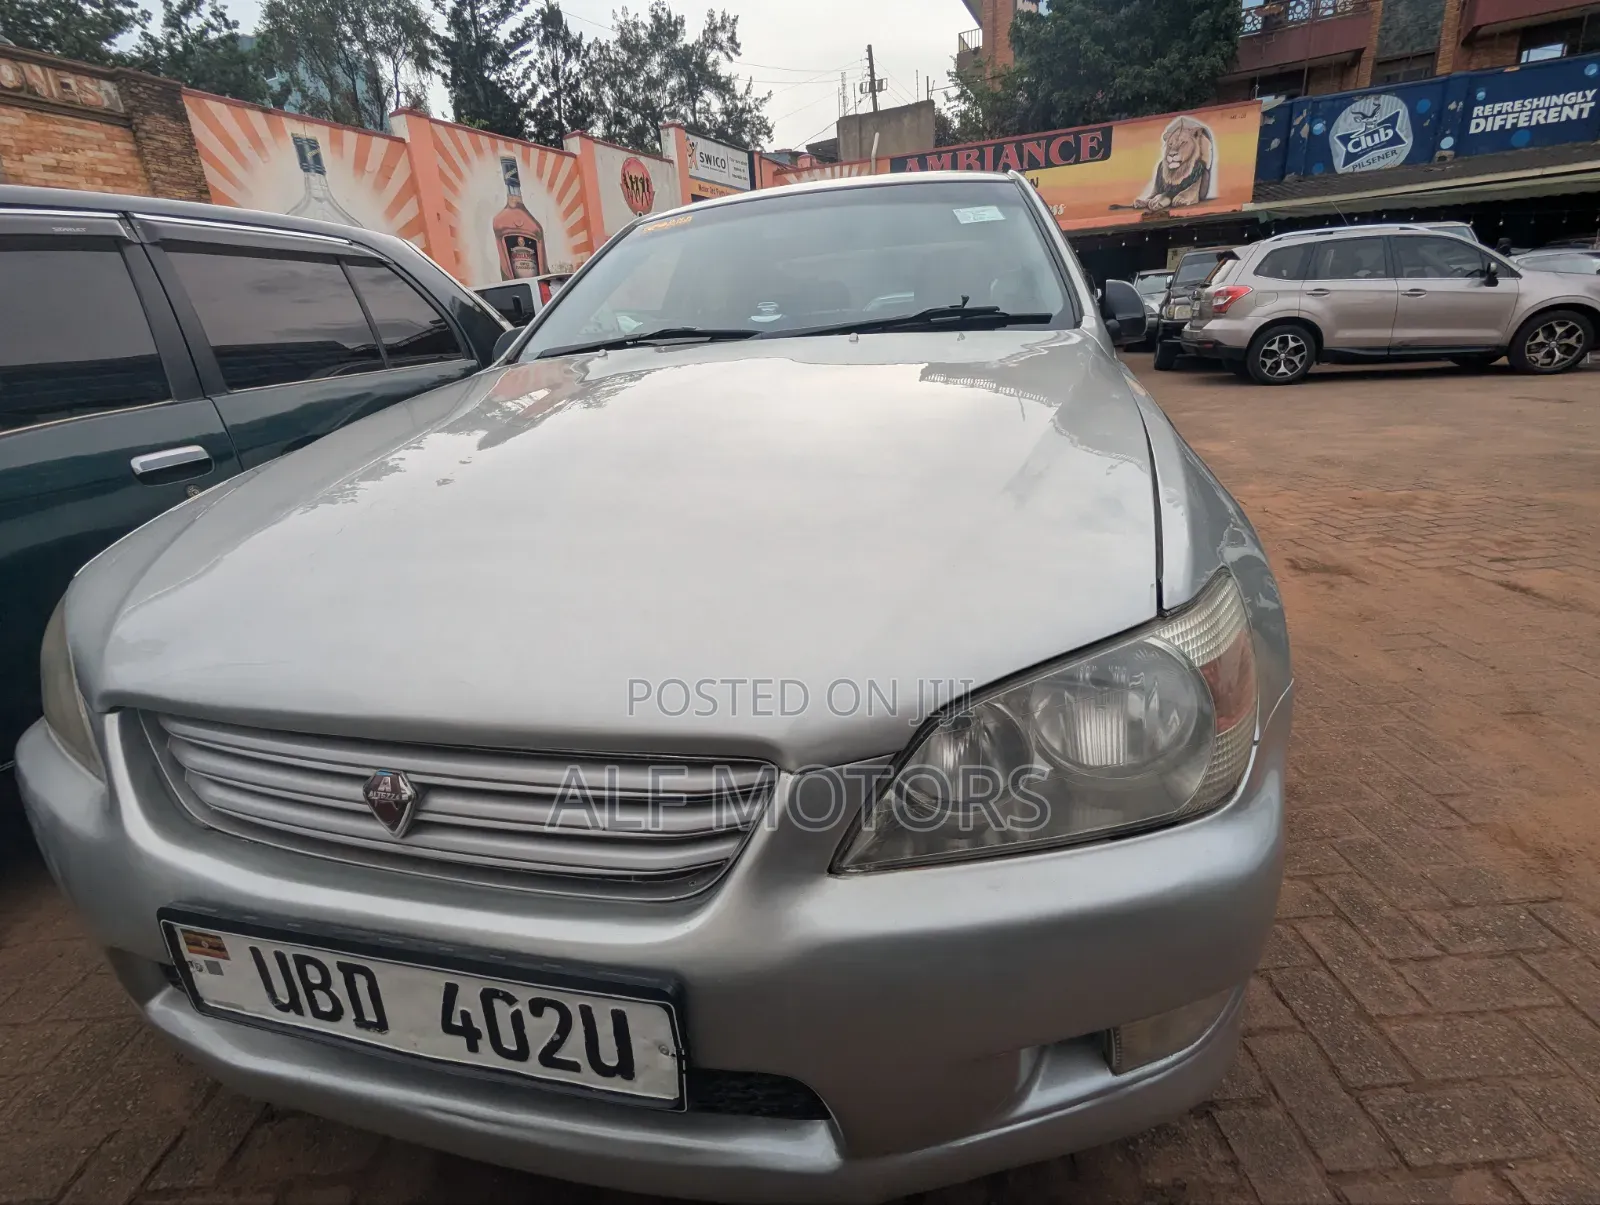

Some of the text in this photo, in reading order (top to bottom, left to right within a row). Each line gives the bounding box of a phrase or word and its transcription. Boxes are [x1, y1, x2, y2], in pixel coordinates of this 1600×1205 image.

[1469, 102, 1595, 134] DIFFERENT
[1472, 89, 1597, 118] REFRESHINGLY
[905, 131, 1104, 172] AMBIANCE
[1347, 127, 1394, 153] Club
[699, 152, 726, 169] SWICO
[1351, 149, 1398, 172] PILSENER
[248, 945, 635, 1081] UBD 402U
